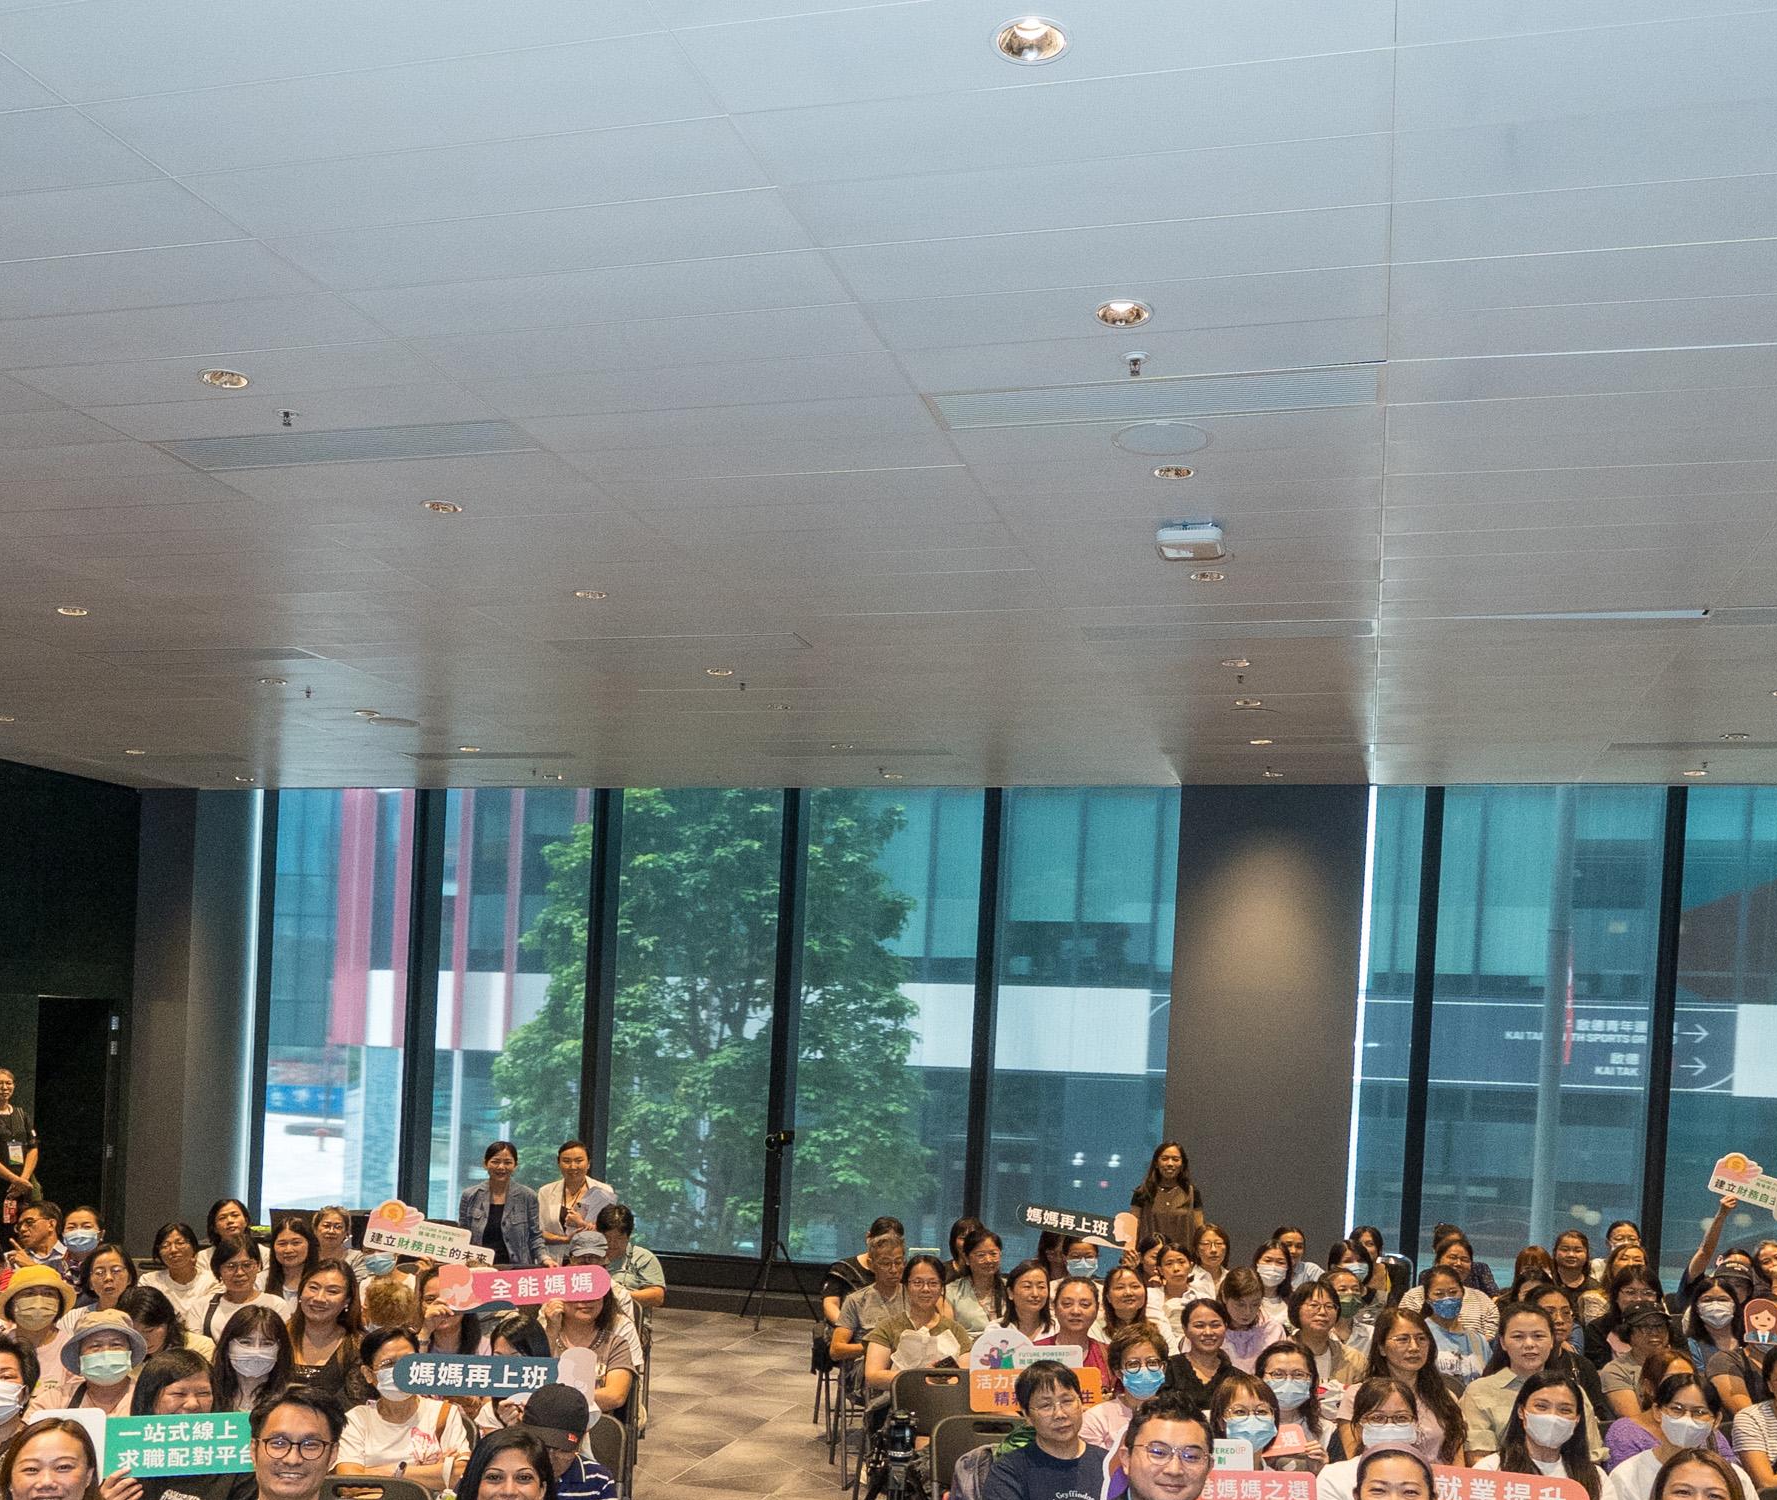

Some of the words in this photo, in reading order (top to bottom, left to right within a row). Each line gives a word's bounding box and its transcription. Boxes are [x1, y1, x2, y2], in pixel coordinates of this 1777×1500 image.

[1026, 1207, 1109, 1237] 媽媽再上班
[369, 1231, 488, 1266] 建立財務自主的未來
[490, 1272, 594, 1300] 全能媽媽
[408, 1361, 549, 1390] 媽媽再上班
[118, 1420, 239, 1443] 一站式線上
[117, 1444, 253, 1470] 求職配對平台
